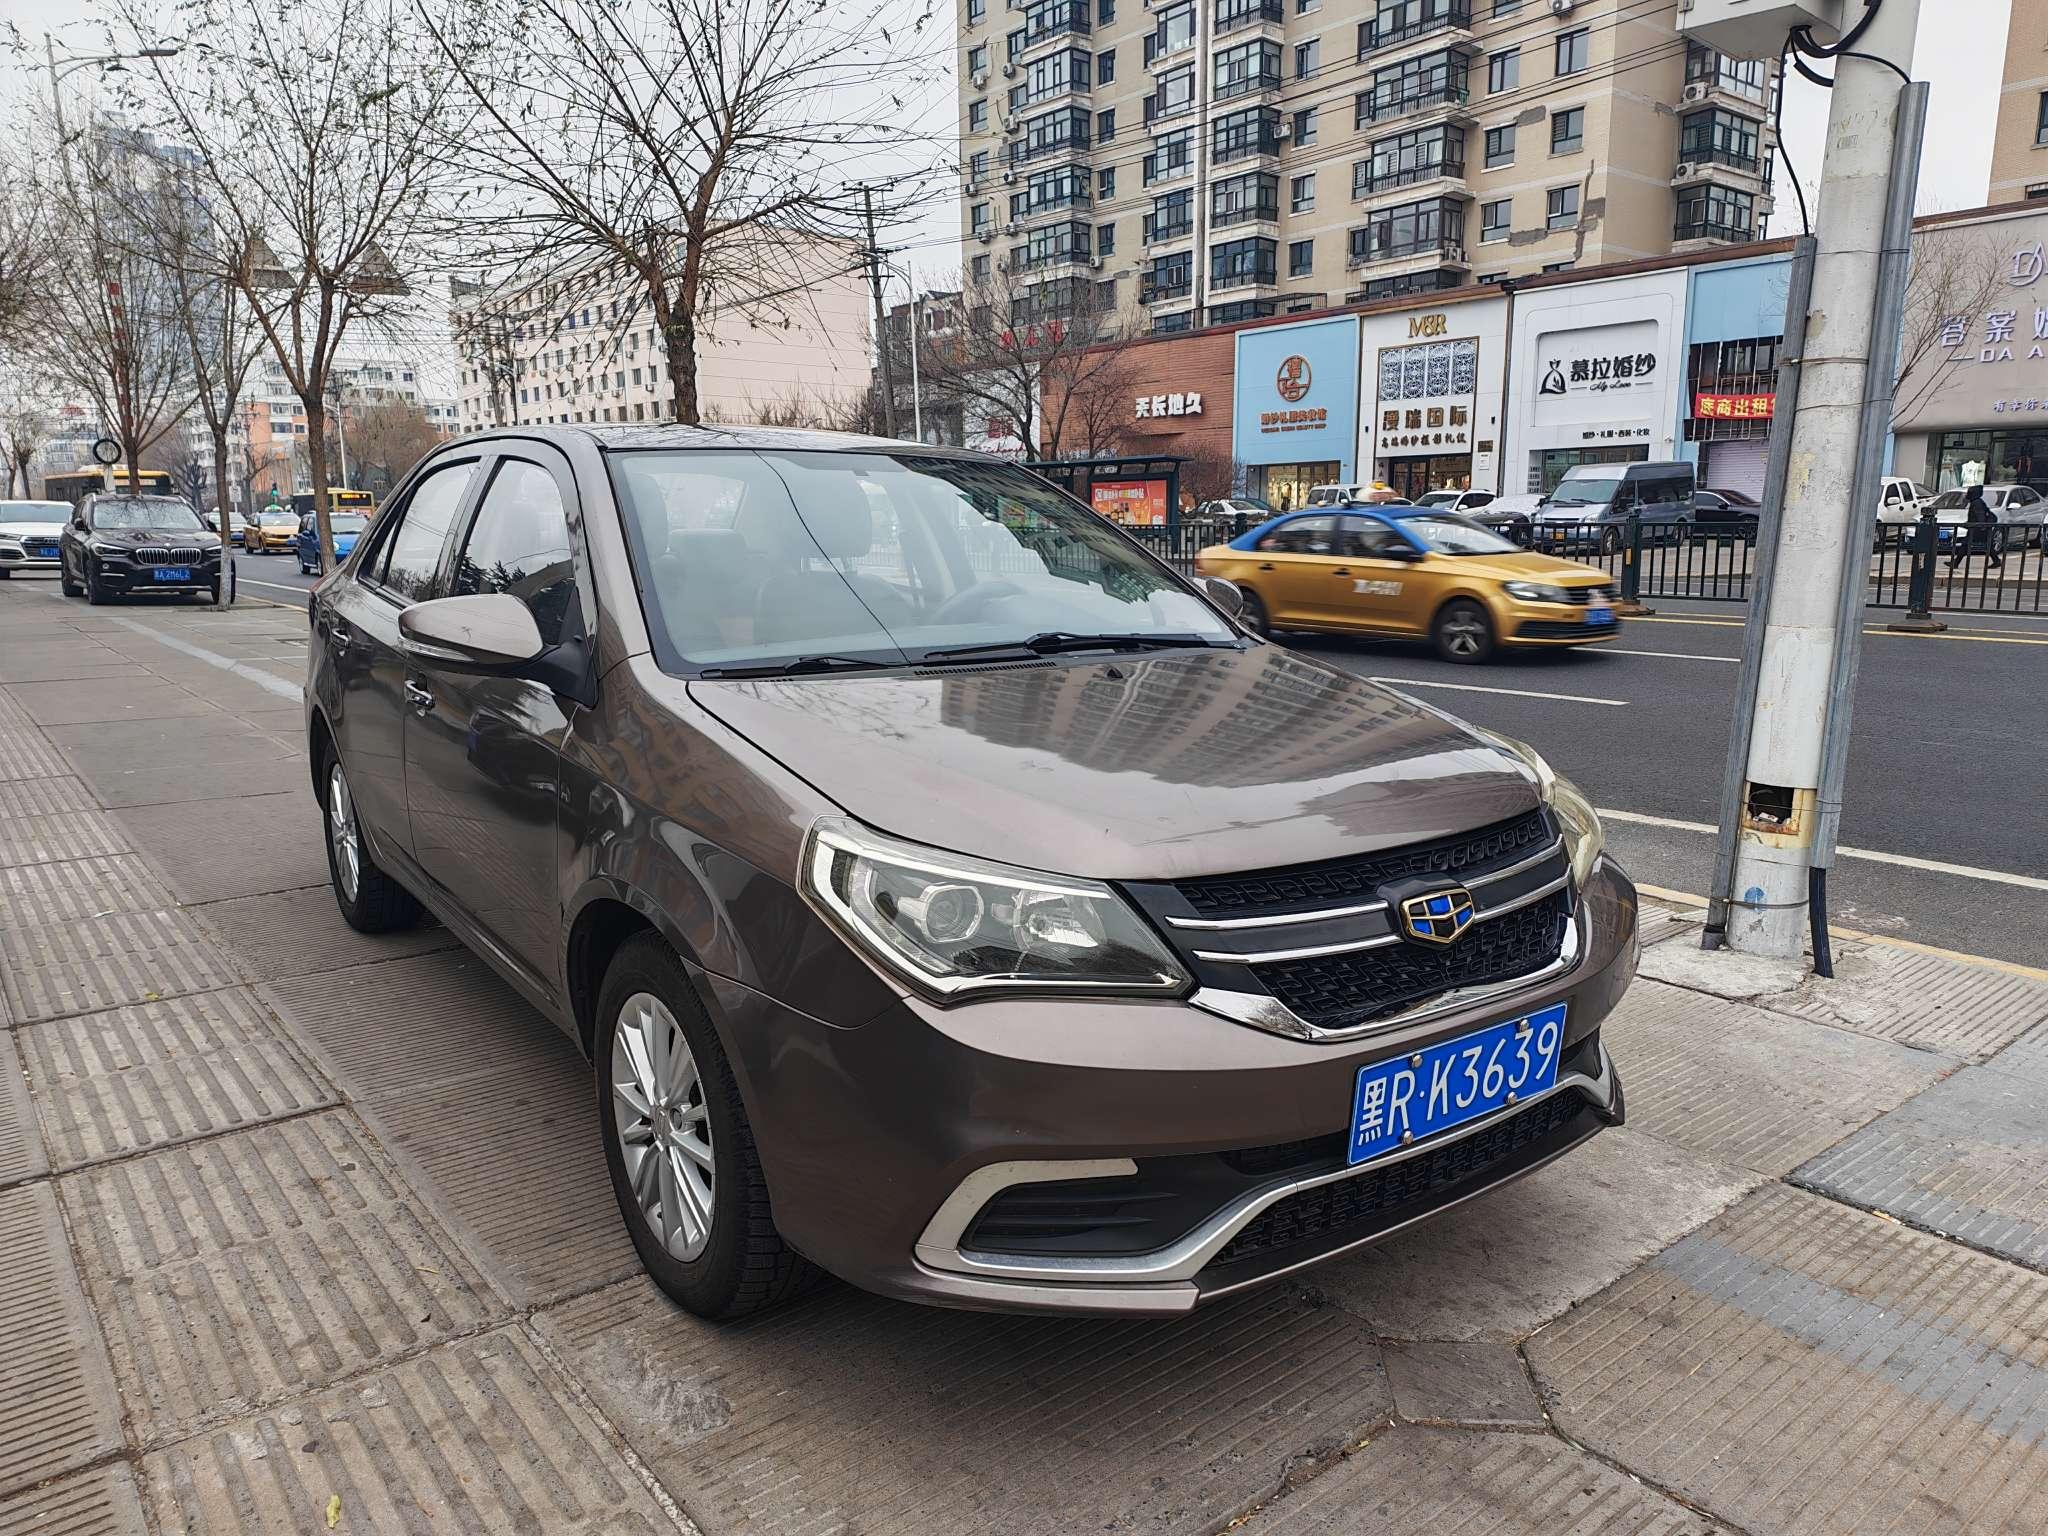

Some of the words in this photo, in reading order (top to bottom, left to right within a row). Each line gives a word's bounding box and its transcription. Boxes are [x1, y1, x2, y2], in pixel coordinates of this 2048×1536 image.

[1408, 313, 1447, 338] M&R
[1570, 352, 1656, 382] 慕拉婚纱
[1980, 347, 2014, 363] DA
[1136, 392, 1202, 418] 天长地久
[1700, 397, 1776, 416] 底商出租
[1358, 1021, 1558, 1146] 黑R·K3639
